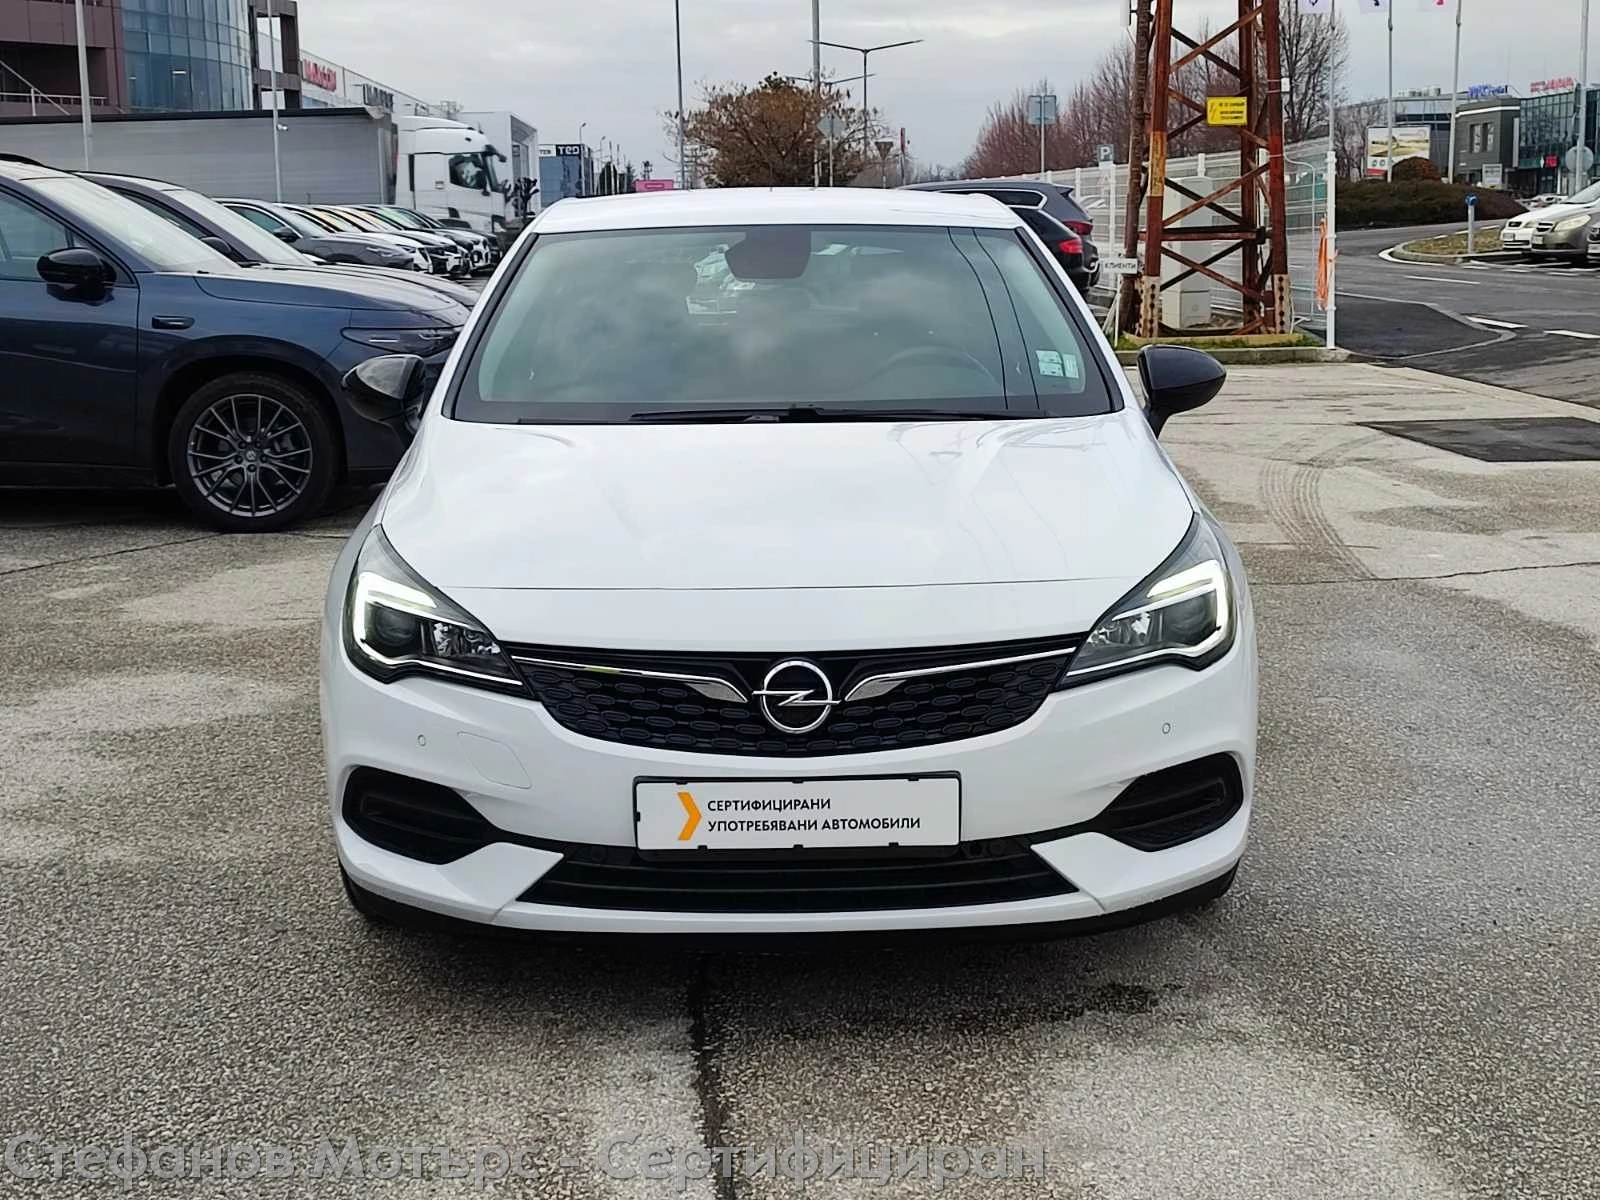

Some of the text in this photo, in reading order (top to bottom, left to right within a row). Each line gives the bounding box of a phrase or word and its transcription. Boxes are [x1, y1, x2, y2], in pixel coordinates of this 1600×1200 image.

[1100, 146, 1111, 160] P
[707, 798, 831, 812] СЕРТИФИЦИРАНИ
[708, 817, 921, 832] УПОТРЕБЯВАНИ АВТОМОБИЛИ
